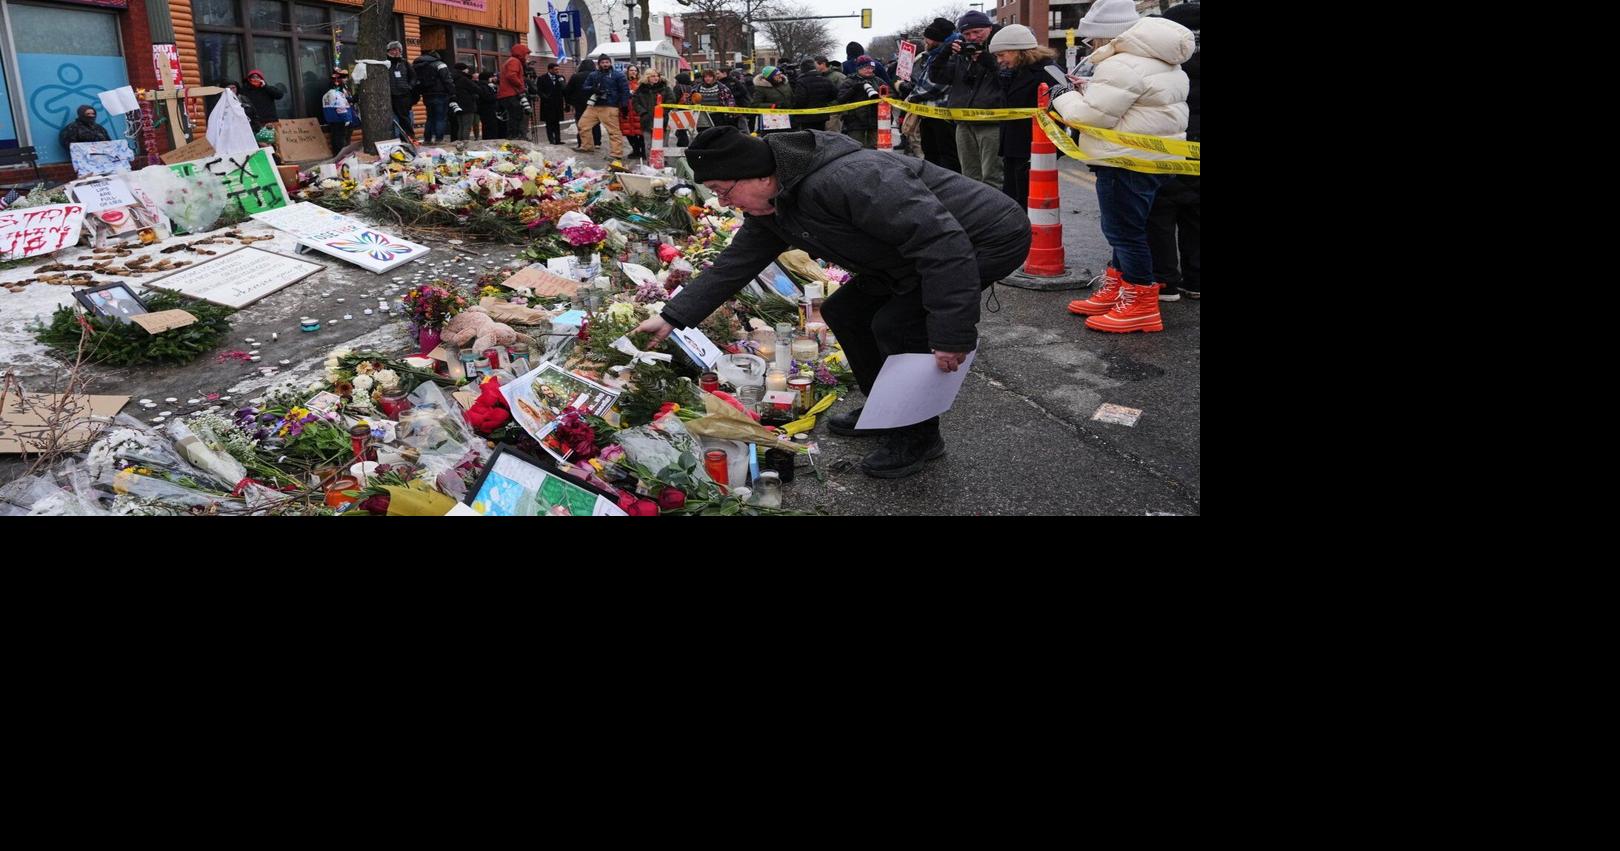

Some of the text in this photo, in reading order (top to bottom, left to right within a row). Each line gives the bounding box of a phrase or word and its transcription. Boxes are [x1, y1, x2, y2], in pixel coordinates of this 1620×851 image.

[152, 44, 174, 53] SHUT
[153, 52, 178, 61] DWN
[0, 205, 82, 229] STOP
